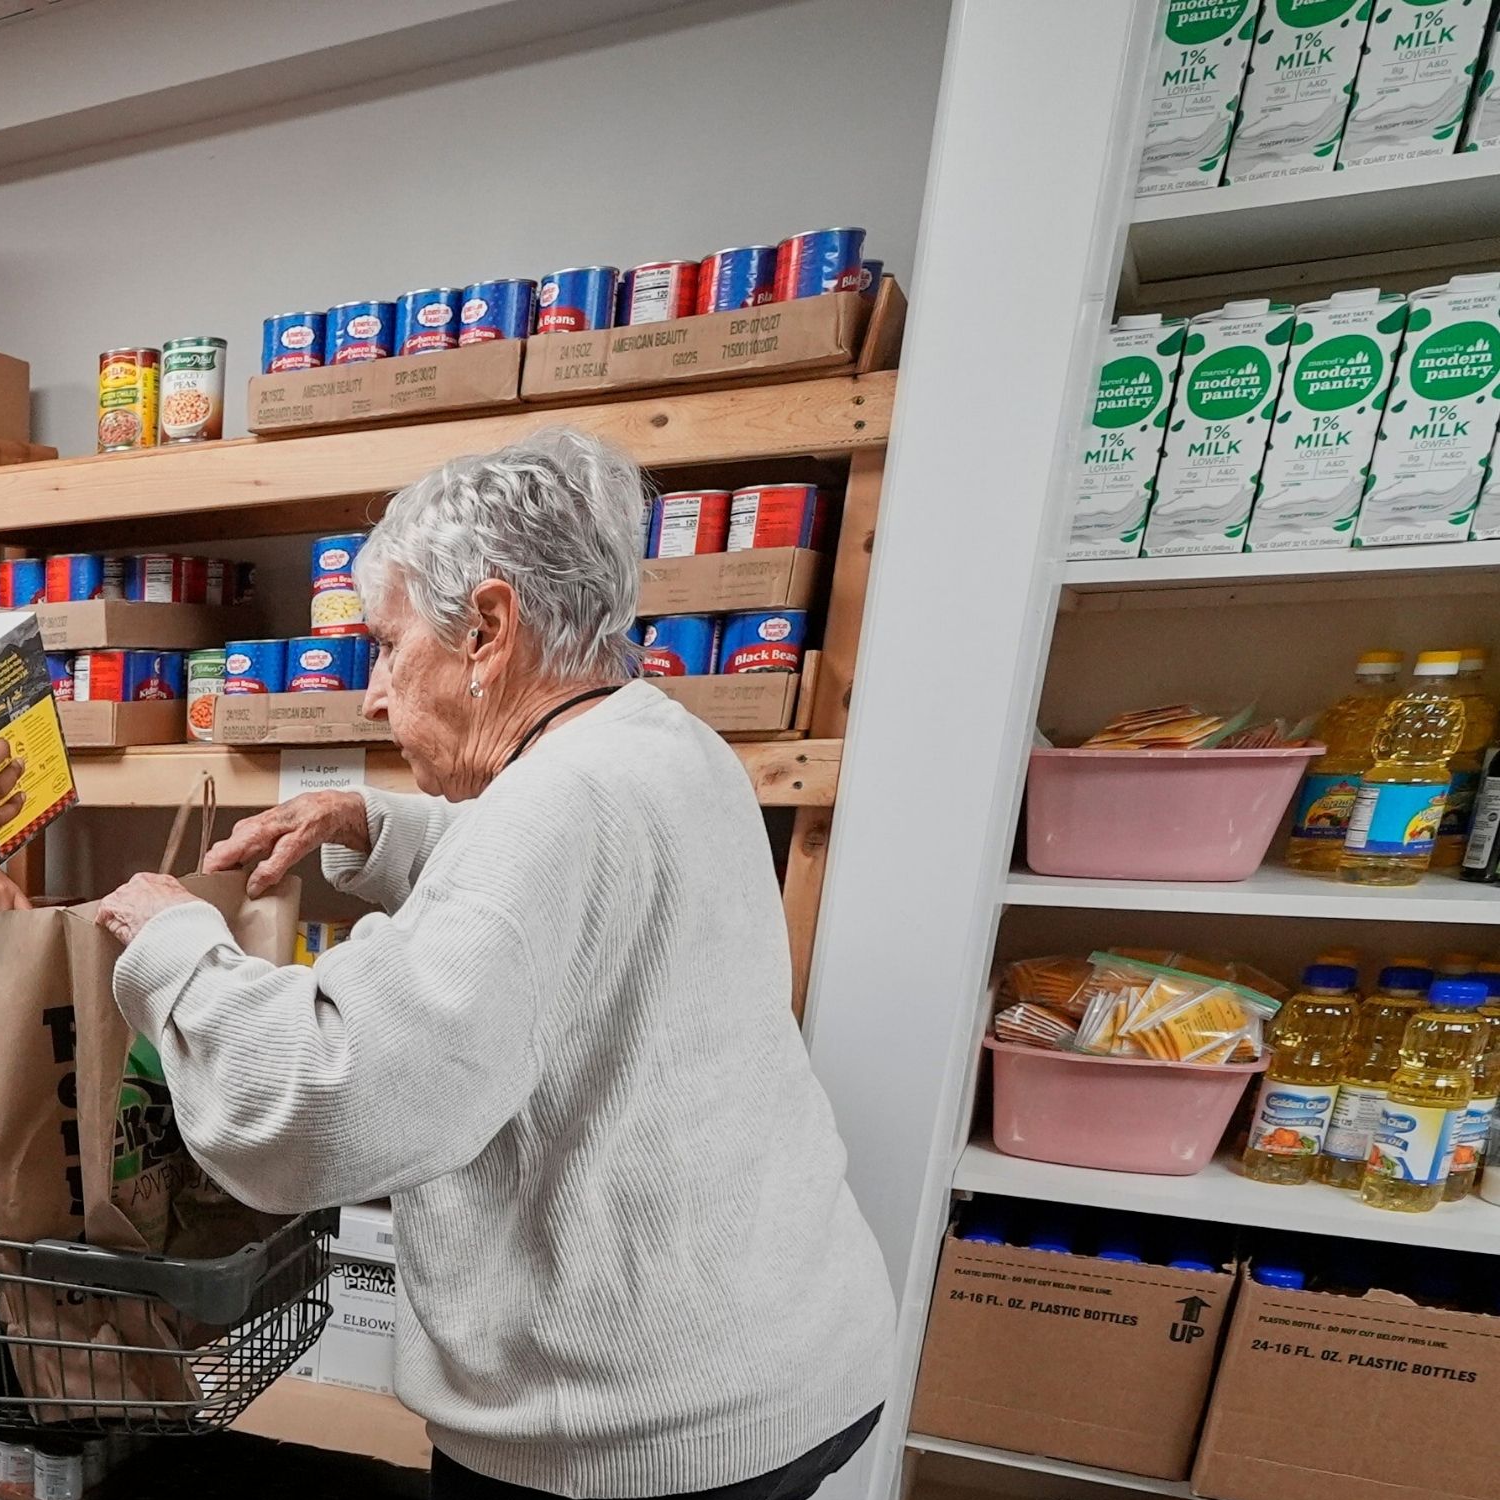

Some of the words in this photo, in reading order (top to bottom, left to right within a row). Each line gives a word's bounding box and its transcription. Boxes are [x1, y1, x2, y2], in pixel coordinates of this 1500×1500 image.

[1177, 4, 1240, 27] pantry
[1414, 9, 1444, 30] 1%
[1294, 31, 1323, 51] 1%
[1394, 25, 1458, 51] MILK
[1181, 48, 1206, 67] 1%
[1275, 46, 1336, 71] MILK
[1398, 46, 1443, 61] LOWFAT
[1163, 64, 1219, 86] MILK
[1281, 66, 1323, 81] LOWFAT
[1167, 83, 1206, 96] LOWFAT
[757, 292, 773, 304] Bla
[544, 314, 575, 327] Beans
[406, 335, 441, 349] Garbanzo
[612, 334, 653, 353] AMERICAN
[655, 329, 688, 345] BEAUTY
[271, 356, 302, 370] Garbanzo
[1418, 352, 1492, 368] modern
[1301, 365, 1371, 380] modern
[1425, 364, 1493, 383] pantry
[173, 380, 197, 389] PEAS
[303, 382, 335, 399] AMERICAN
[336, 378, 363, 394] BEAUTY
[1194, 375, 1261, 390] modern
[1308, 377, 1373, 395] pantry
[1096, 395, 1155, 412] pantry
[1200, 386, 1262, 405] pantry
[1428, 405, 1457, 421] 1%
[1312, 416, 1339, 431] 1%
[1410, 421, 1470, 439] MILK
[1100, 433, 1125, 447] 1%
[1204, 425, 1230, 440] 1%
[1295, 431, 1351, 449] MILK
[1188, 440, 1242, 457] MILK
[1415, 439, 1457, 449] LOWFAT
[1084, 448, 1136, 464] MILK
[1192, 456, 1230, 466] LOWFAT
[1300, 448, 1339, 458] LOWFAT
[735, 650, 769, 666] Black
[771, 649, 797, 663] Bean
[301, 706, 326, 719] BEAUTY
[315, 765, 321, 774] 4
[323, 765, 339, 776] per
[301, 778, 350, 788] Household
[1268, 1097, 1304, 1109] Golden
[1306, 1097, 1329, 1110] Chef
[1387, 1117, 1411, 1129] Chef
[950, 1289, 983, 1305] 24-16
[986, 1294, 1003, 1307] FL.
[1008, 1297, 1026, 1311] OZ.
[1030, 1301, 1081, 1319] PLASTIC
[1084, 1309, 1139, 1327] BOTTLES
[1169, 1322, 1205, 1344] UP
[1258, 1315, 1291, 1326] PLASTIC
[1291, 1320, 1322, 1331] BOTTLE
[1340, 1327, 1357, 1336] NOT
[1407, 1337, 1426, 1346] THIS
[1251, 1338, 1292, 1355] 24-16
[1294, 1345, 1315, 1359] FL.
[1321, 1349, 1342, 1363] OZ.
[1347, 1354, 1408, 1373] PLASTIC
[1411, 1363, 1477, 1383] BOTTLES
